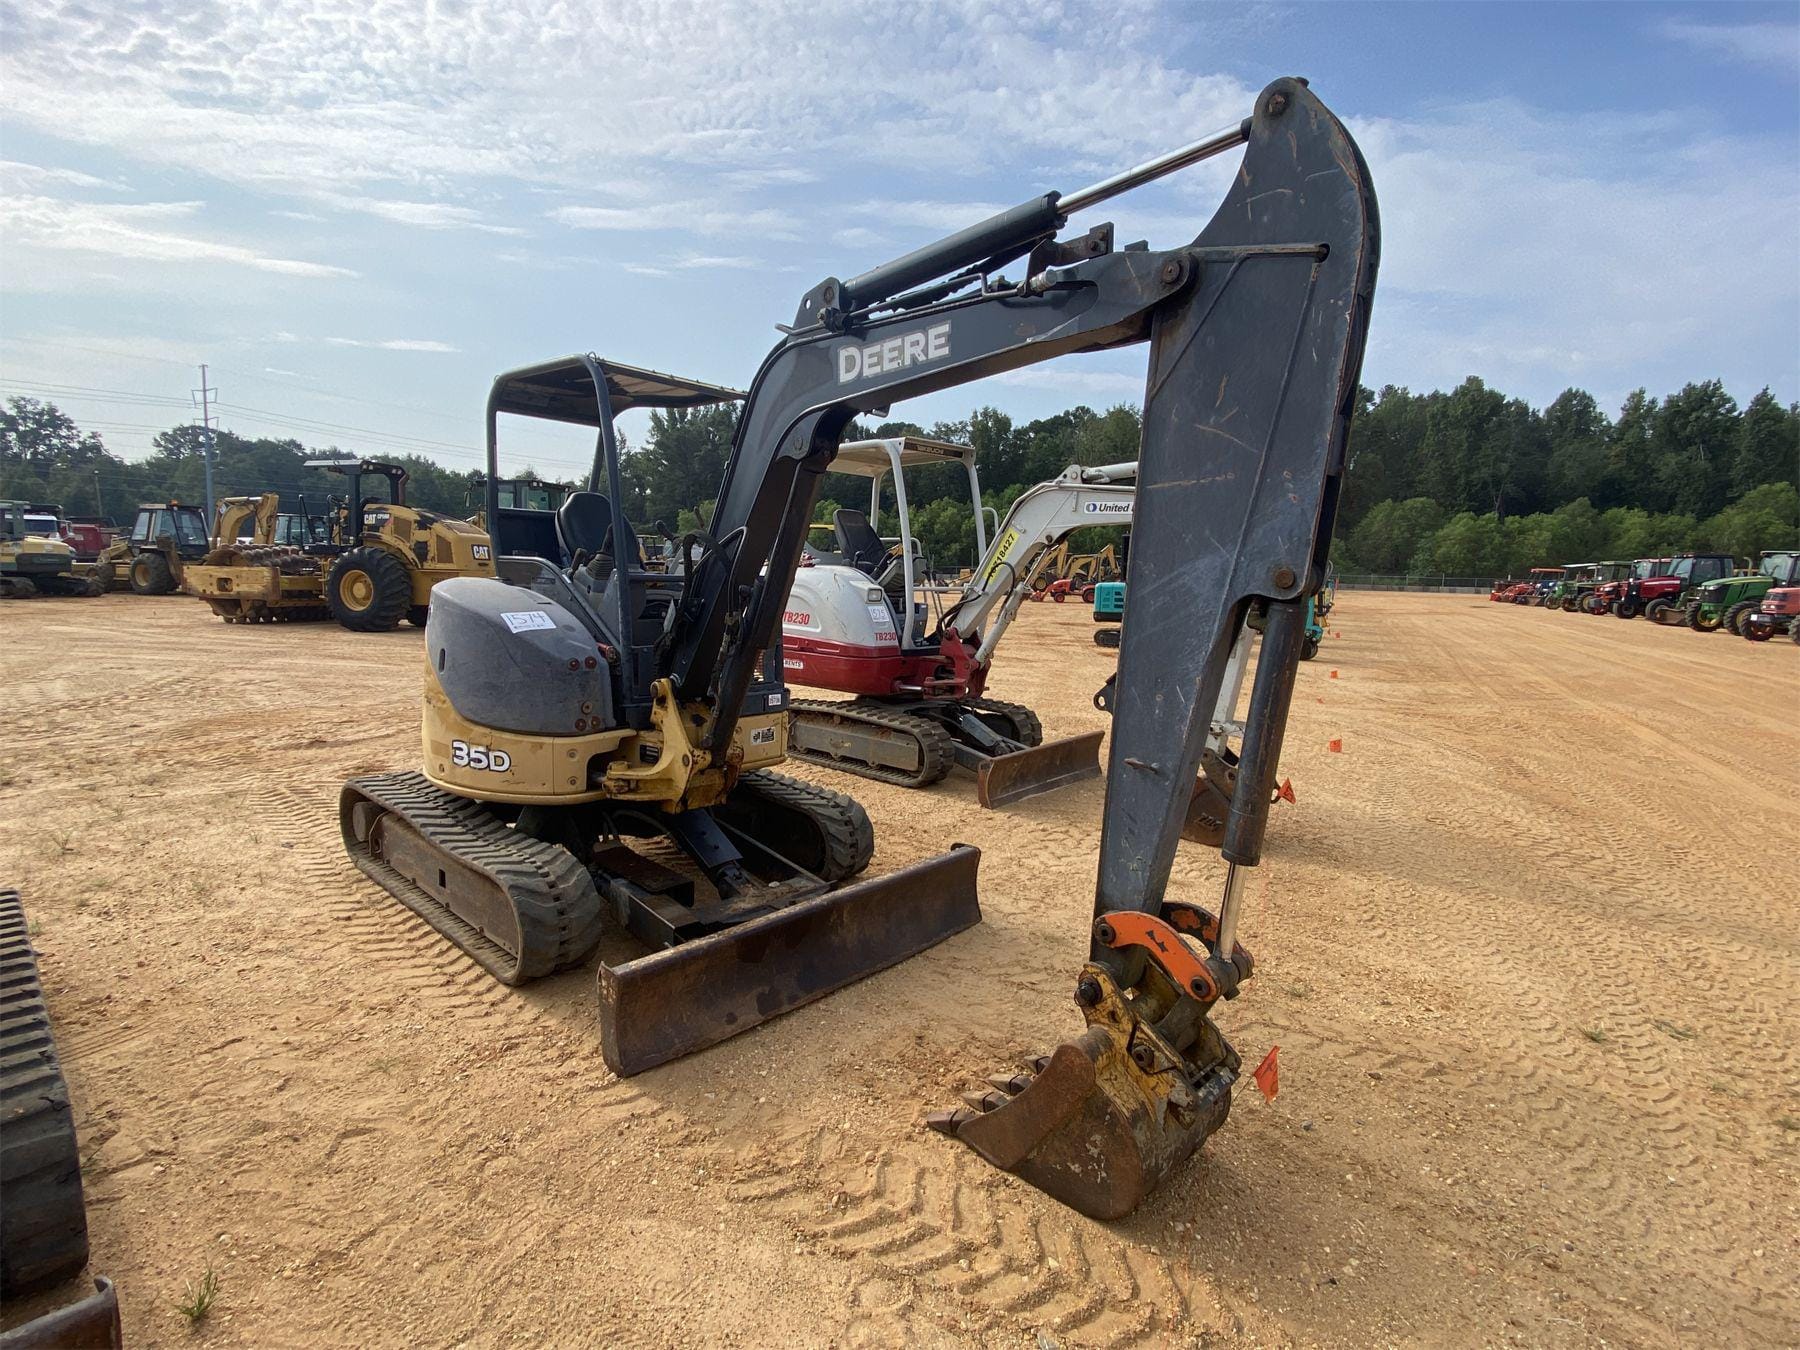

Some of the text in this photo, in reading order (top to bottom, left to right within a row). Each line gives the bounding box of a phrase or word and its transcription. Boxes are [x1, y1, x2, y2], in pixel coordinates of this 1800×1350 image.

[838, 322, 951, 384] DEERE
[1098, 503, 1131, 513] United
[364, 513, 377, 525] CAT
[473, 545, 488, 559] CAT
[783, 611, 810, 625] TB230
[874, 632, 898, 641] TB230
[452, 739, 512, 772] 35D
